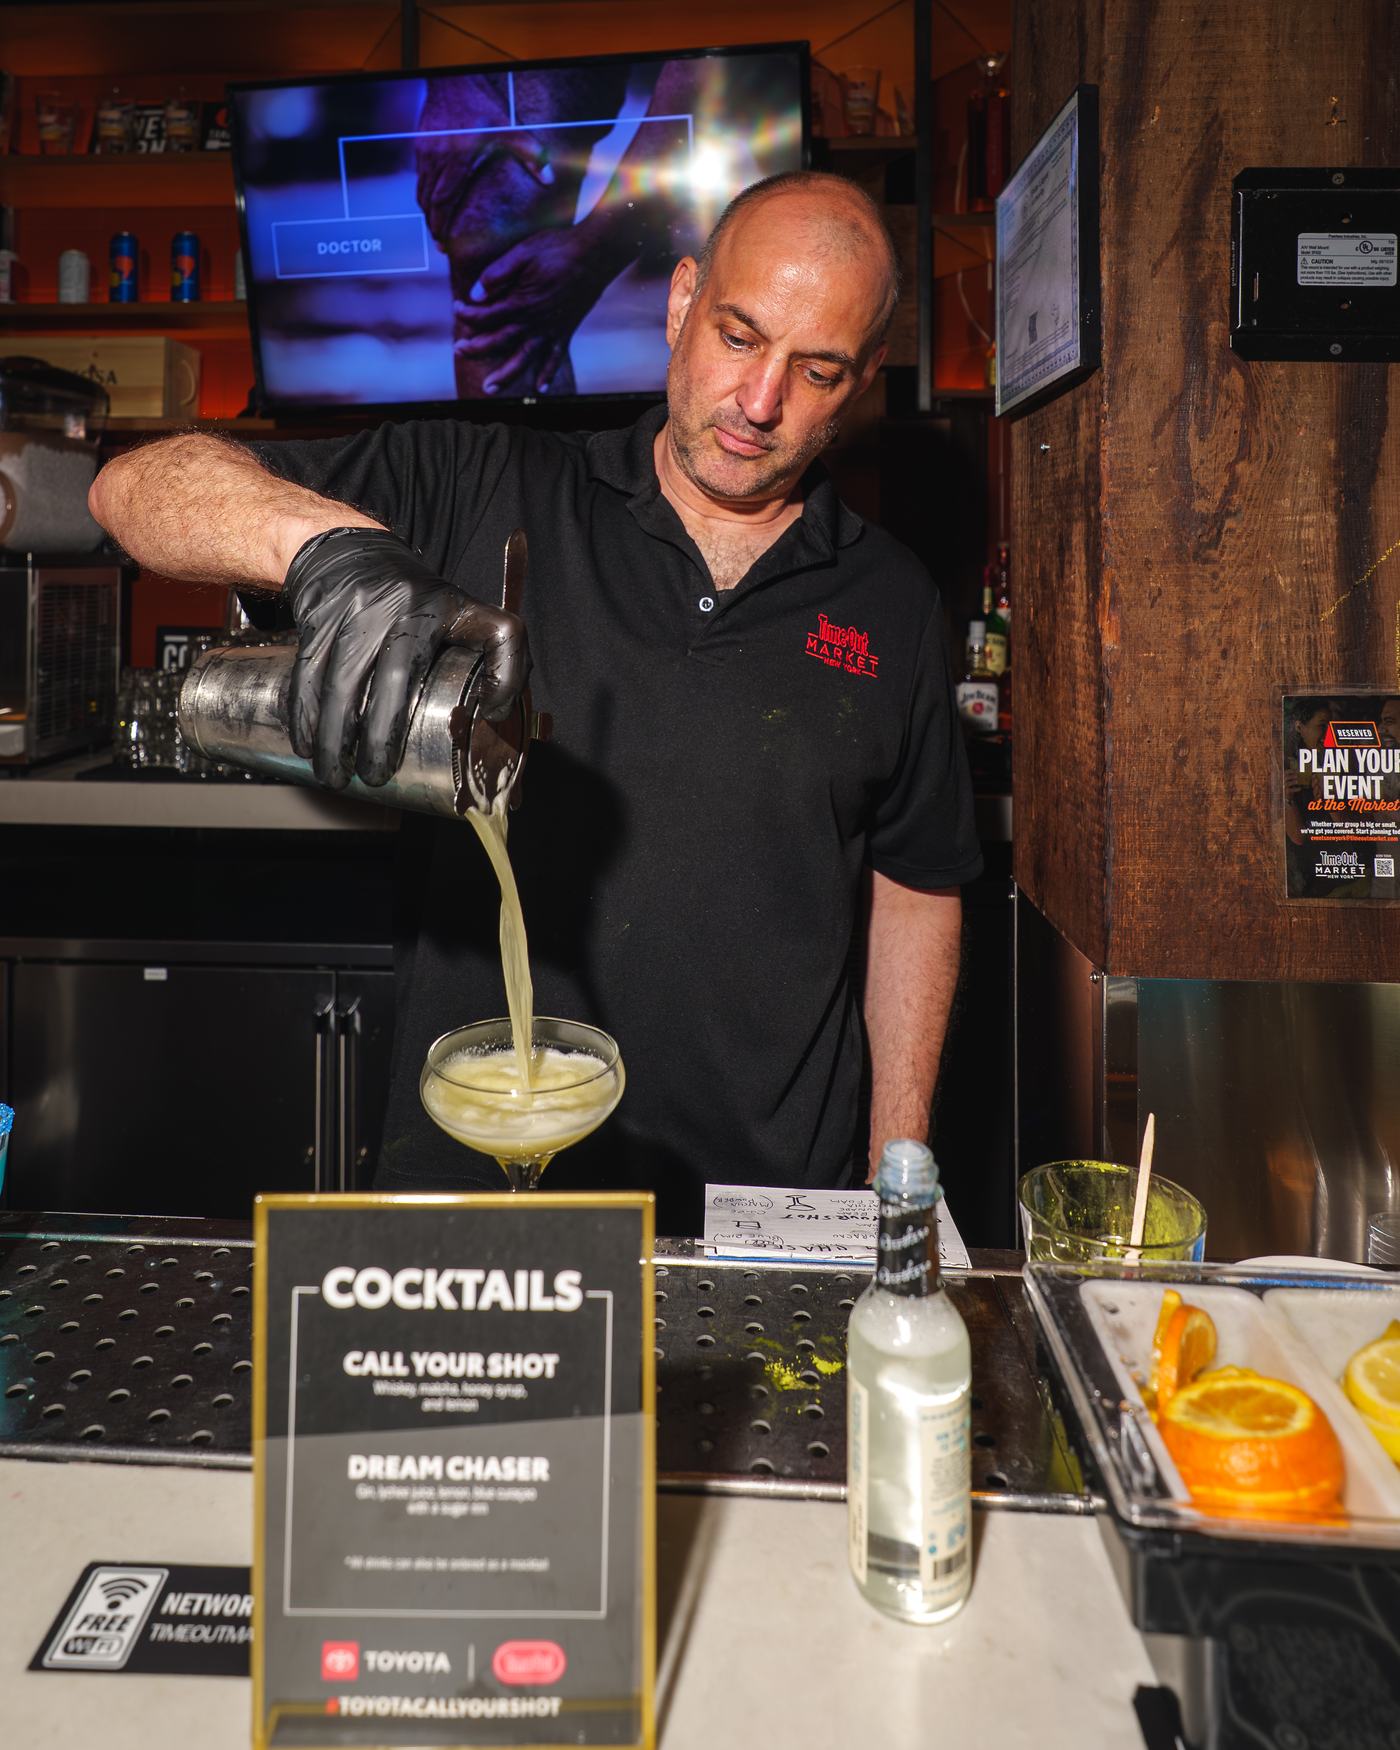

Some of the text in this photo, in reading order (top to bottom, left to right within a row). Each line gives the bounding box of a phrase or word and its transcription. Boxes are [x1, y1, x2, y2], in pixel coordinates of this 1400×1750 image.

[317, 238, 382, 255] DOCTOR
[806, 637, 878, 673] MARKET
[1336, 729, 1373, 737] RESERVED
[1299, 748, 1350, 773] PLAN
[1323, 776, 1384, 800] EVENT
[1308, 797, 1400, 814] at the Market
[322, 1266, 584, 1312] COCKTAILS
[343, 1350, 560, 1379] CALL YOUR SHOT
[348, 1454, 550, 1482] DREAM CHASER
[161, 1593, 254, 1616] NETWOR
[75, 1614, 134, 1632] FREE
[150, 1624, 254, 1644] TIMEOUTMA
[365, 1650, 450, 1674] TOYOTA
[325, 1696, 562, 1718] #TOYOTACALLYOURSHOT
